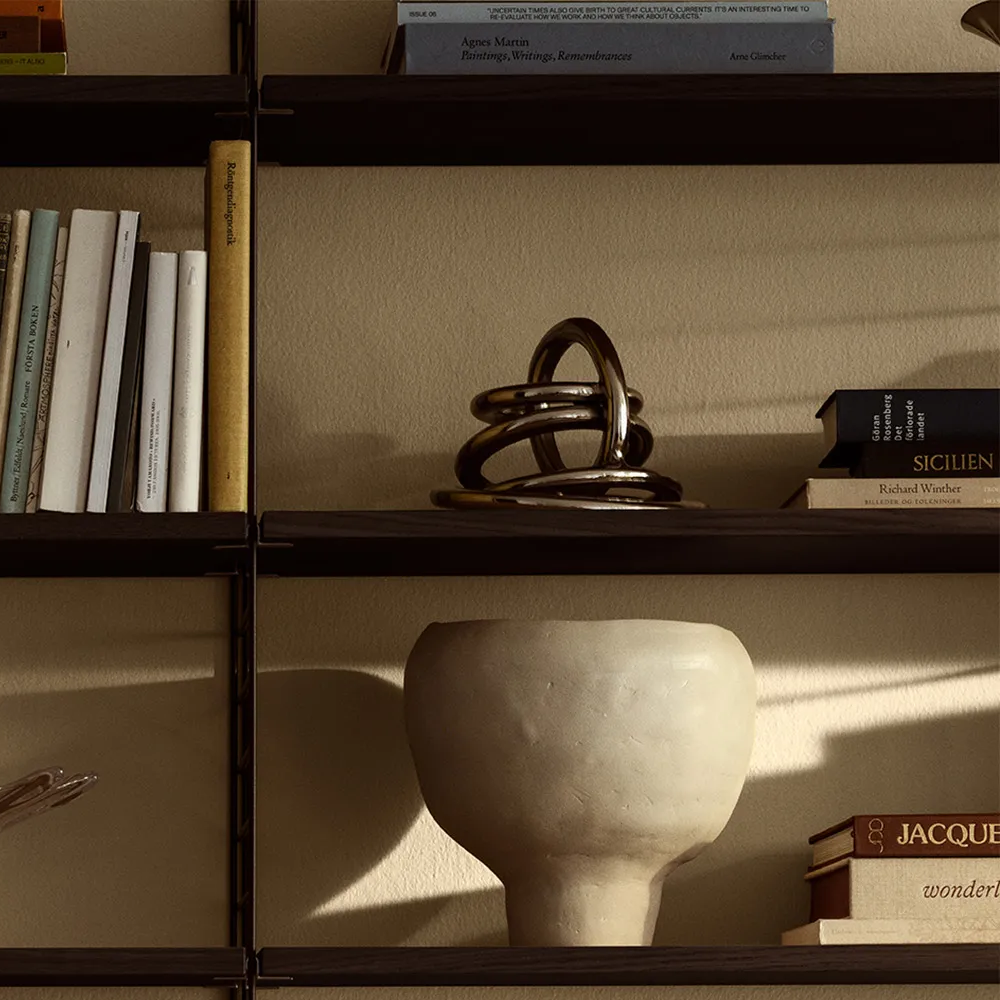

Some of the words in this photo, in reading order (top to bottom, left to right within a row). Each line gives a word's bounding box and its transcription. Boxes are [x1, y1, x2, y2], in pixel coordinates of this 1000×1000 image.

[461, 37, 491, 48] Agnes
[494, 37, 529, 47] Martin
[461, 50, 511, 62] Paintings,
[511, 50, 555, 62] Writings,
[557, 50, 632, 61] Remembrances
[224, 163, 236, 246] Röntgendiagnostik
[29, 305, 39, 336] BOKEN
[25, 339, 36, 372] FÖRSTA
[872, 415, 880, 441] Göran
[883, 394, 893, 441] Rosenberg
[905, 400, 914, 441] förlorade
[916, 412, 925, 441] landet
[894, 426, 902, 441] Det
[913, 453, 994, 472] SICILIEN
[879, 484, 918, 494] Richard
[920, 484, 961, 494] Winther
